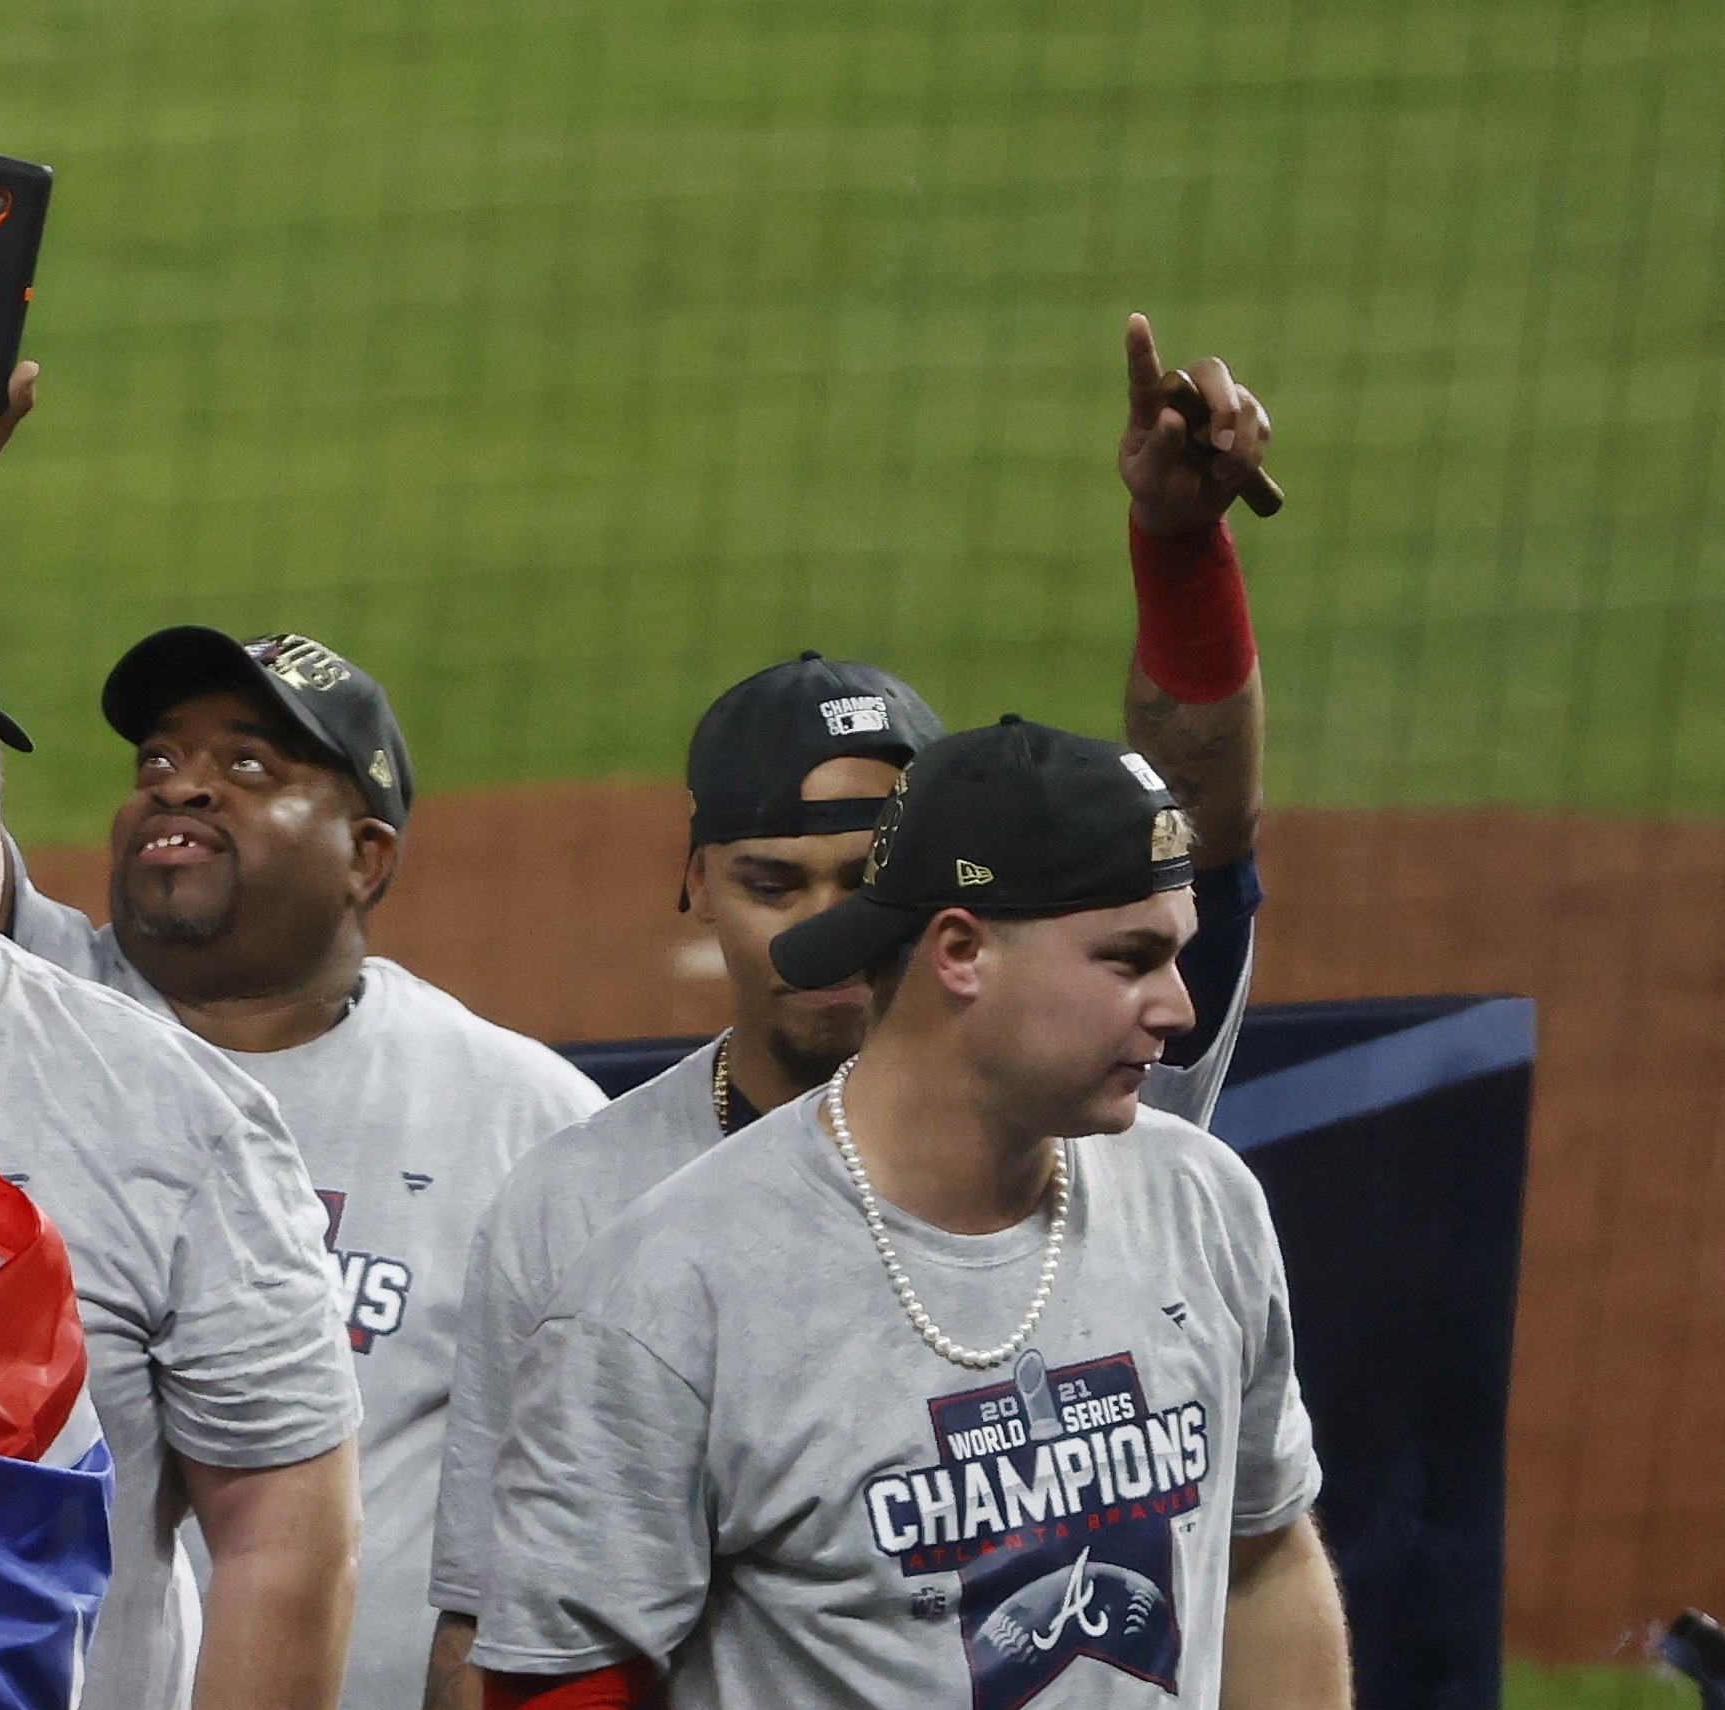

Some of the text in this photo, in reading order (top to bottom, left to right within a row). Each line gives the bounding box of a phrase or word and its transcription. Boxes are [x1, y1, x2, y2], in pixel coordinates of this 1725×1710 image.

[820, 696, 887, 718] CHAMPS
[948, 1391, 1137, 1461] WORLD SERIES
[980, 1378, 1092, 1423] 20 21
[866, 1404, 1208, 1554] CHAMPIONS
[908, 1486, 1197, 1569] ATLANTA BRAVES
[1032, 1546, 1108, 1650] A
